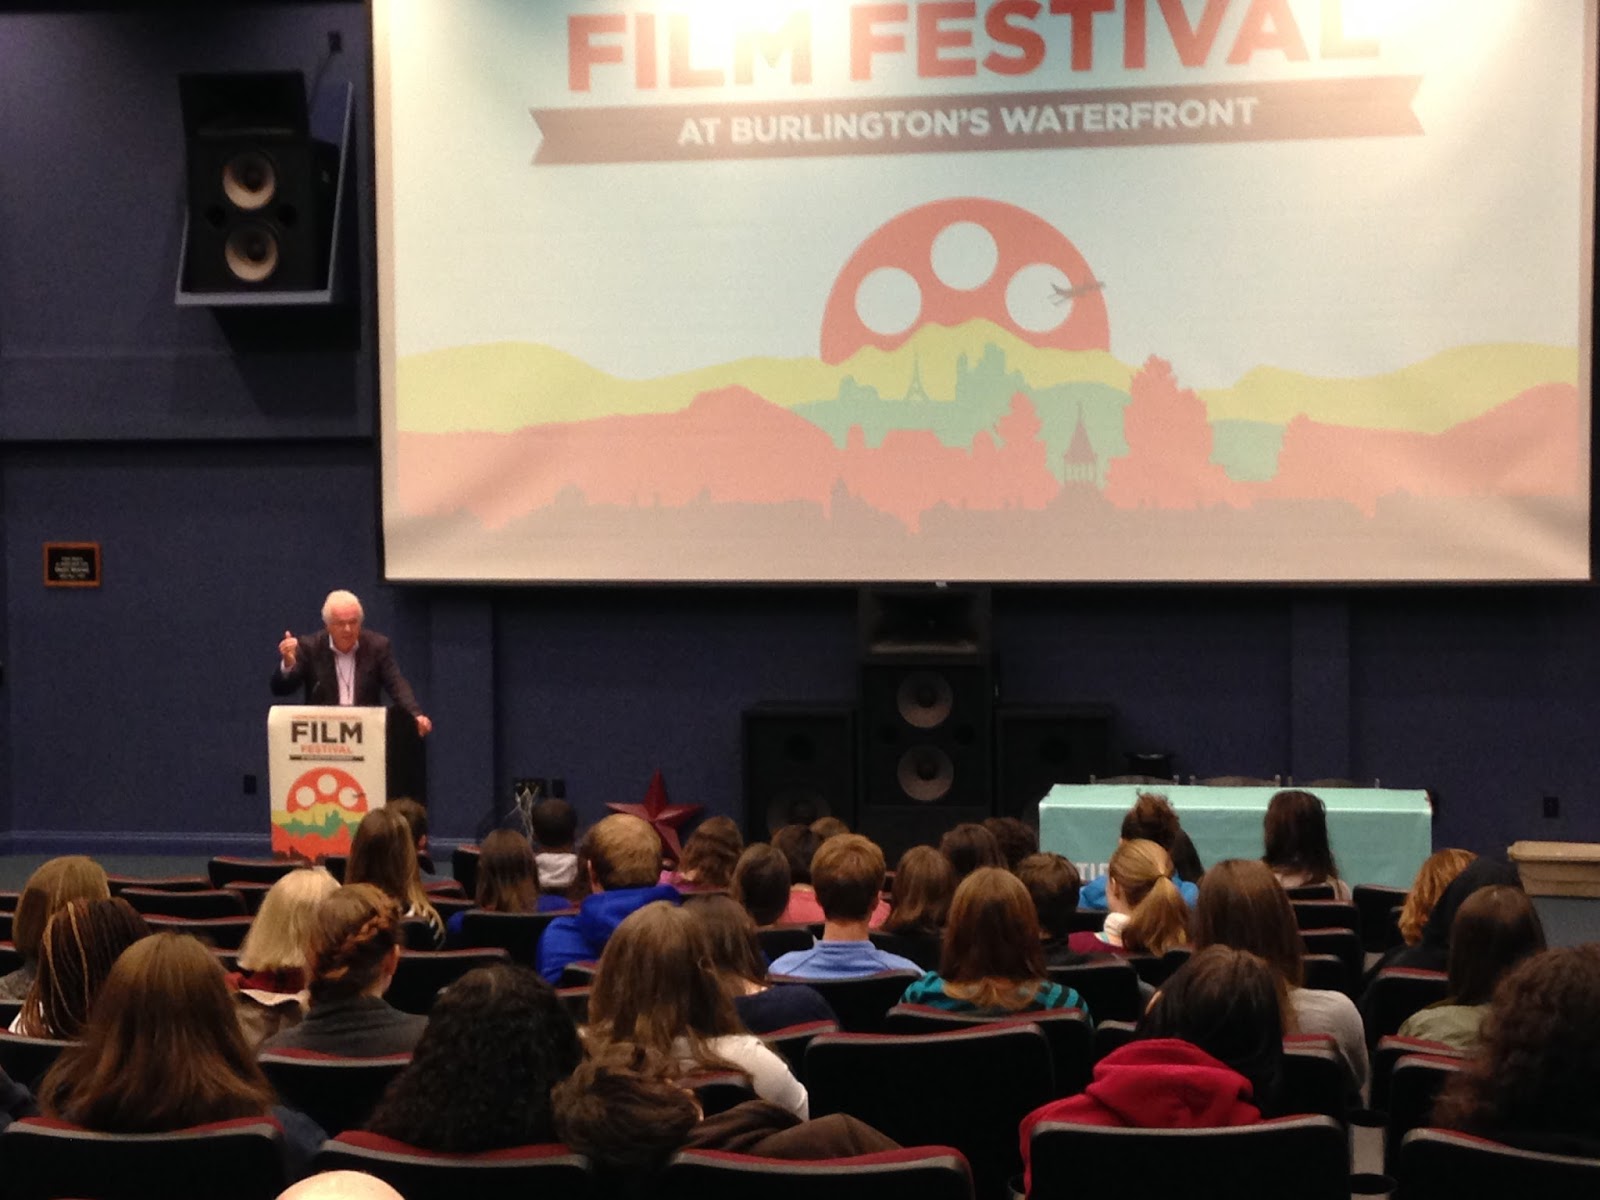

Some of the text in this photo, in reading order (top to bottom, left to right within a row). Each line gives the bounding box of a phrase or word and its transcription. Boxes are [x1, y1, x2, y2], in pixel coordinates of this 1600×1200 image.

[567, 0, 1381, 92] FILM FESTIVAL
[678, 97, 1260, 146] AT BURLINGTON'S WATERFRONT
[291, 721, 363, 744] FILM
[301, 744, 353, 754] FESTIVAL
